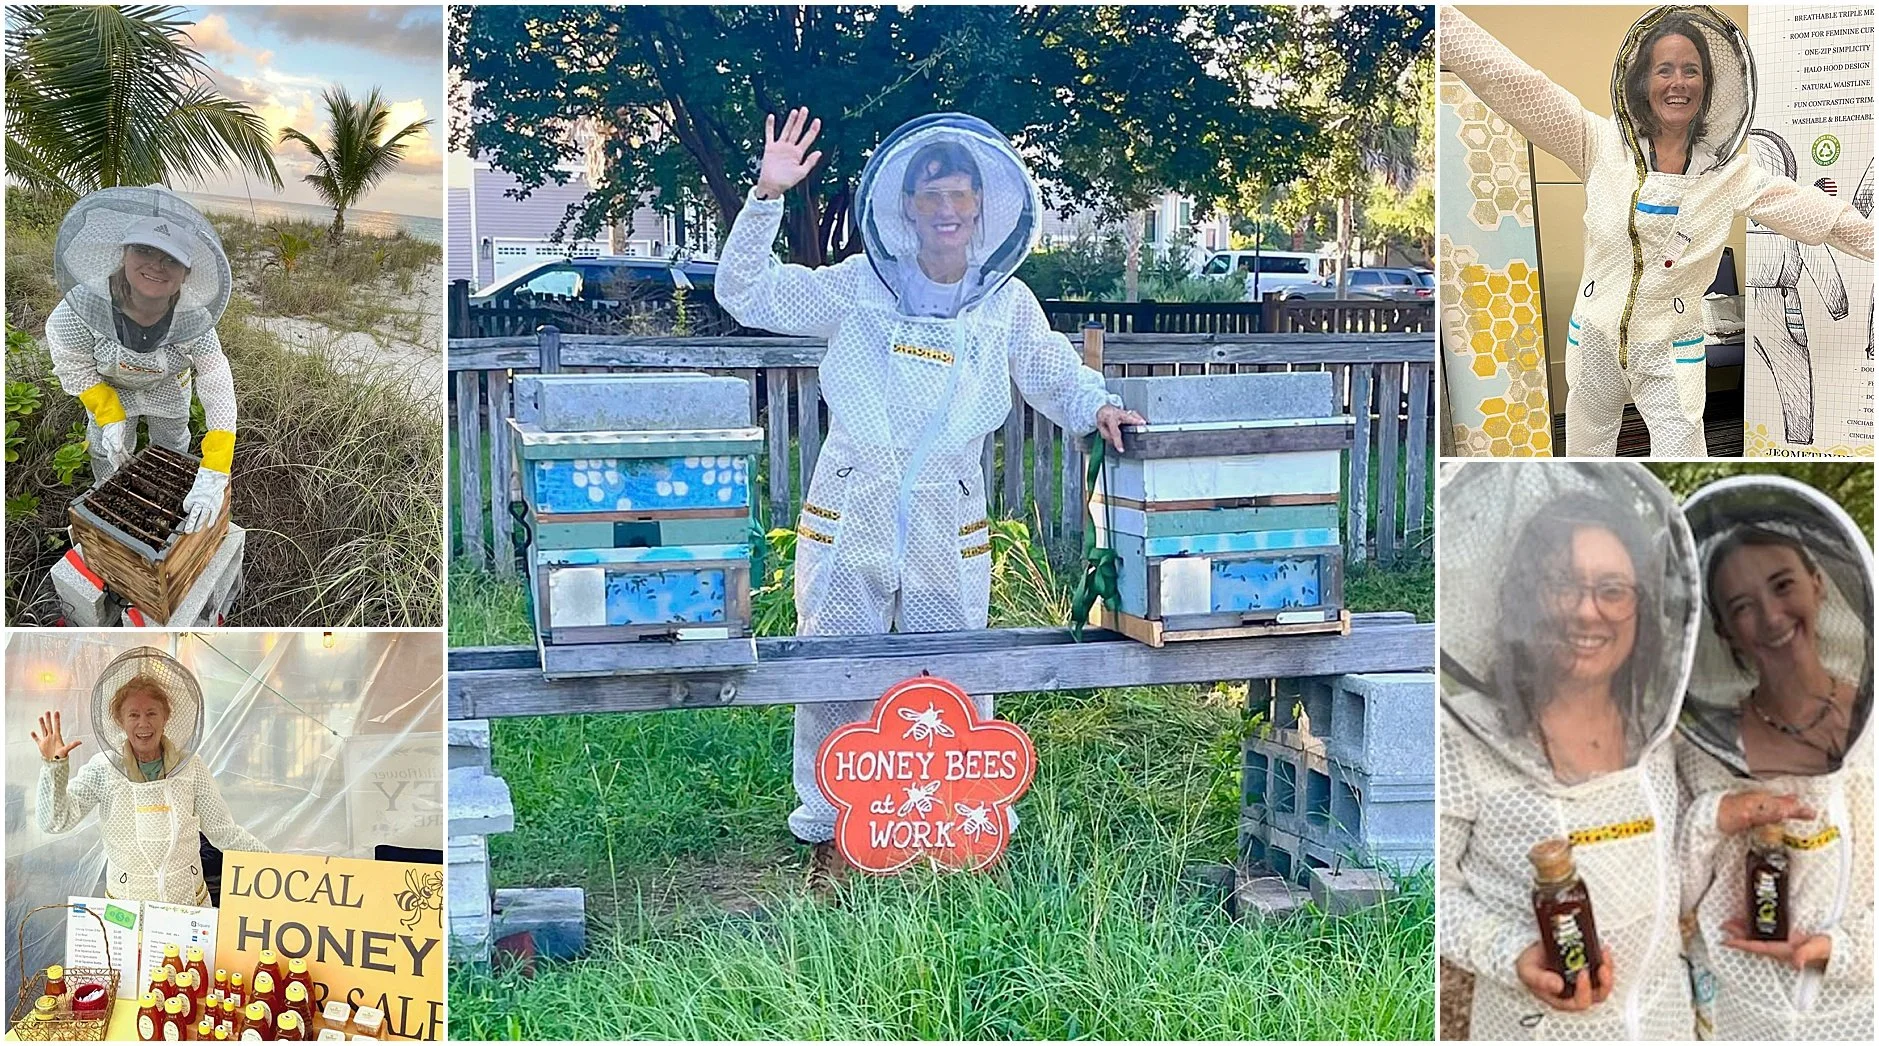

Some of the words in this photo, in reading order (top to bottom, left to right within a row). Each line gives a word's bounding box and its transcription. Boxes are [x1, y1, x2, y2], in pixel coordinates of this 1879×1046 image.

[1794, 12, 1837, 22] BREATHABLE
[1838, 10, 1863, 19] TRIPLE
[1789, 32, 1810, 40] ROOM
[1825, 28, 1859, 37] FEMININE
[1804, 47, 1831, 56] ONE-ZIP
[1832, 44, 1871, 54] SIMPLICITY
[1803, 65, 1822, 74] HALO
[1823, 64, 1843, 72] HOOD
[1844, 62, 1870, 70] DESIGN
[1801, 82, 1832, 91] NATURAL
[1833, 79, 1871, 88] WAISTLINE
[1793, 101, 1807, 109] FUN
[1808, 98, 1855, 108] CONTRASTING
[1791, 117, 1827, 125] WASHABLE
[1834, 114, 1874, 122] BLEACHABL
[835, 751, 936, 782] HONEY
[945, 750, 1017, 781] BEES
[870, 793, 896, 814] at
[869, 820, 956, 849] WORK
[229, 865, 364, 909] LOCAL
[236, 916, 440, 978] HONEY
